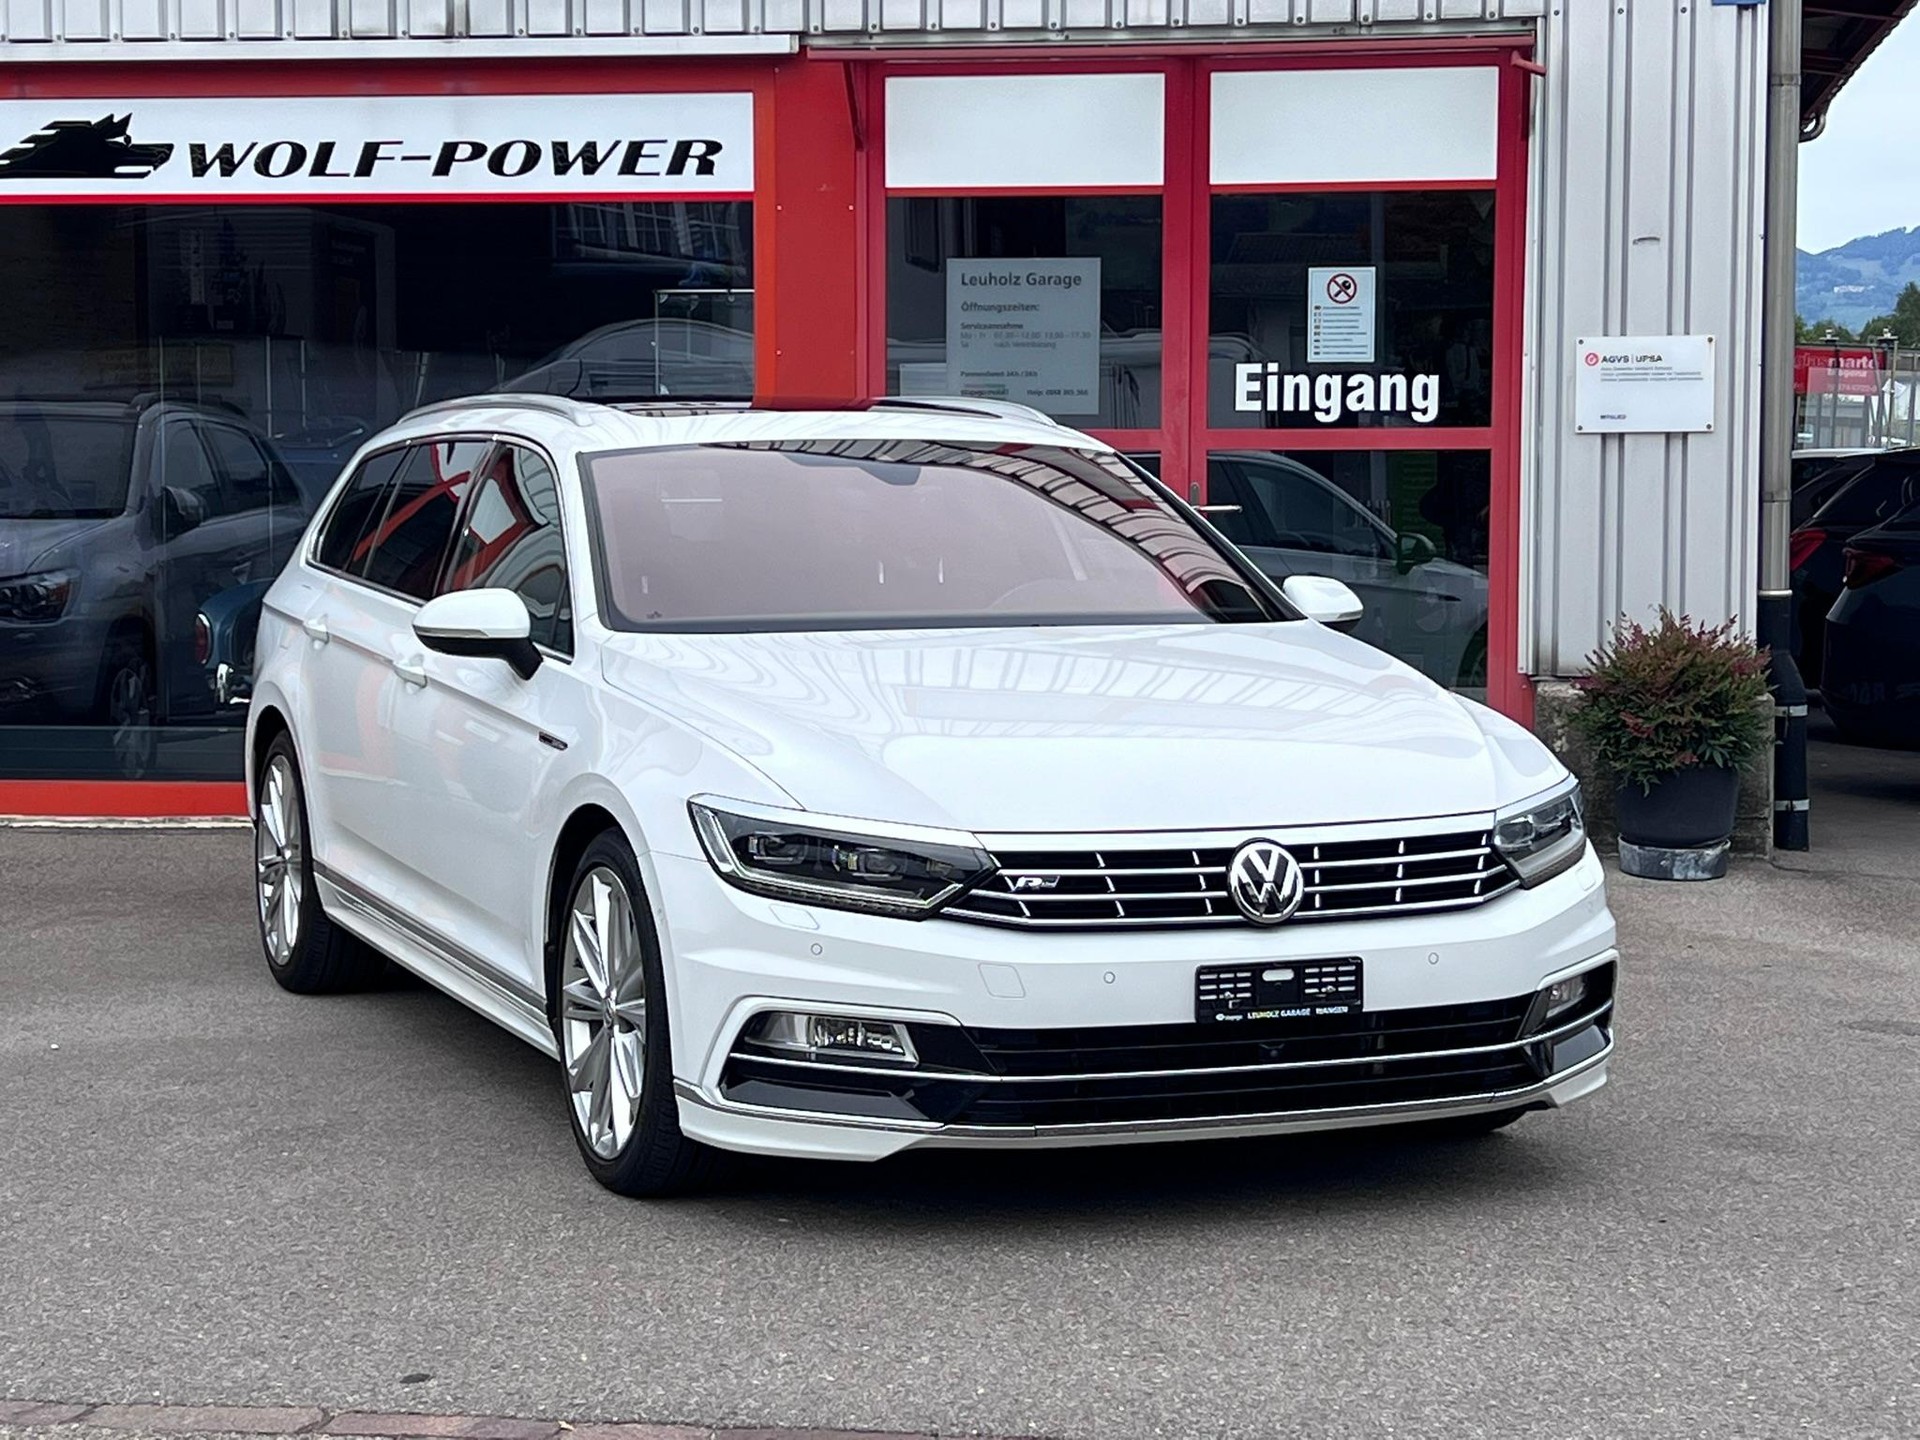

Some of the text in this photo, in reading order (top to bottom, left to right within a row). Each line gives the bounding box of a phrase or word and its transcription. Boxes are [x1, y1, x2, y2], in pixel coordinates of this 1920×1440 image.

[189, 138, 724, 178] WOLF-POWER
[961, 272, 1082, 289] Leuholz Garage
[1601, 355, 1630, 363] AGVS
[1235, 362, 1440, 423] Eingang
[1280, 1008, 1311, 1017] GARAGE
